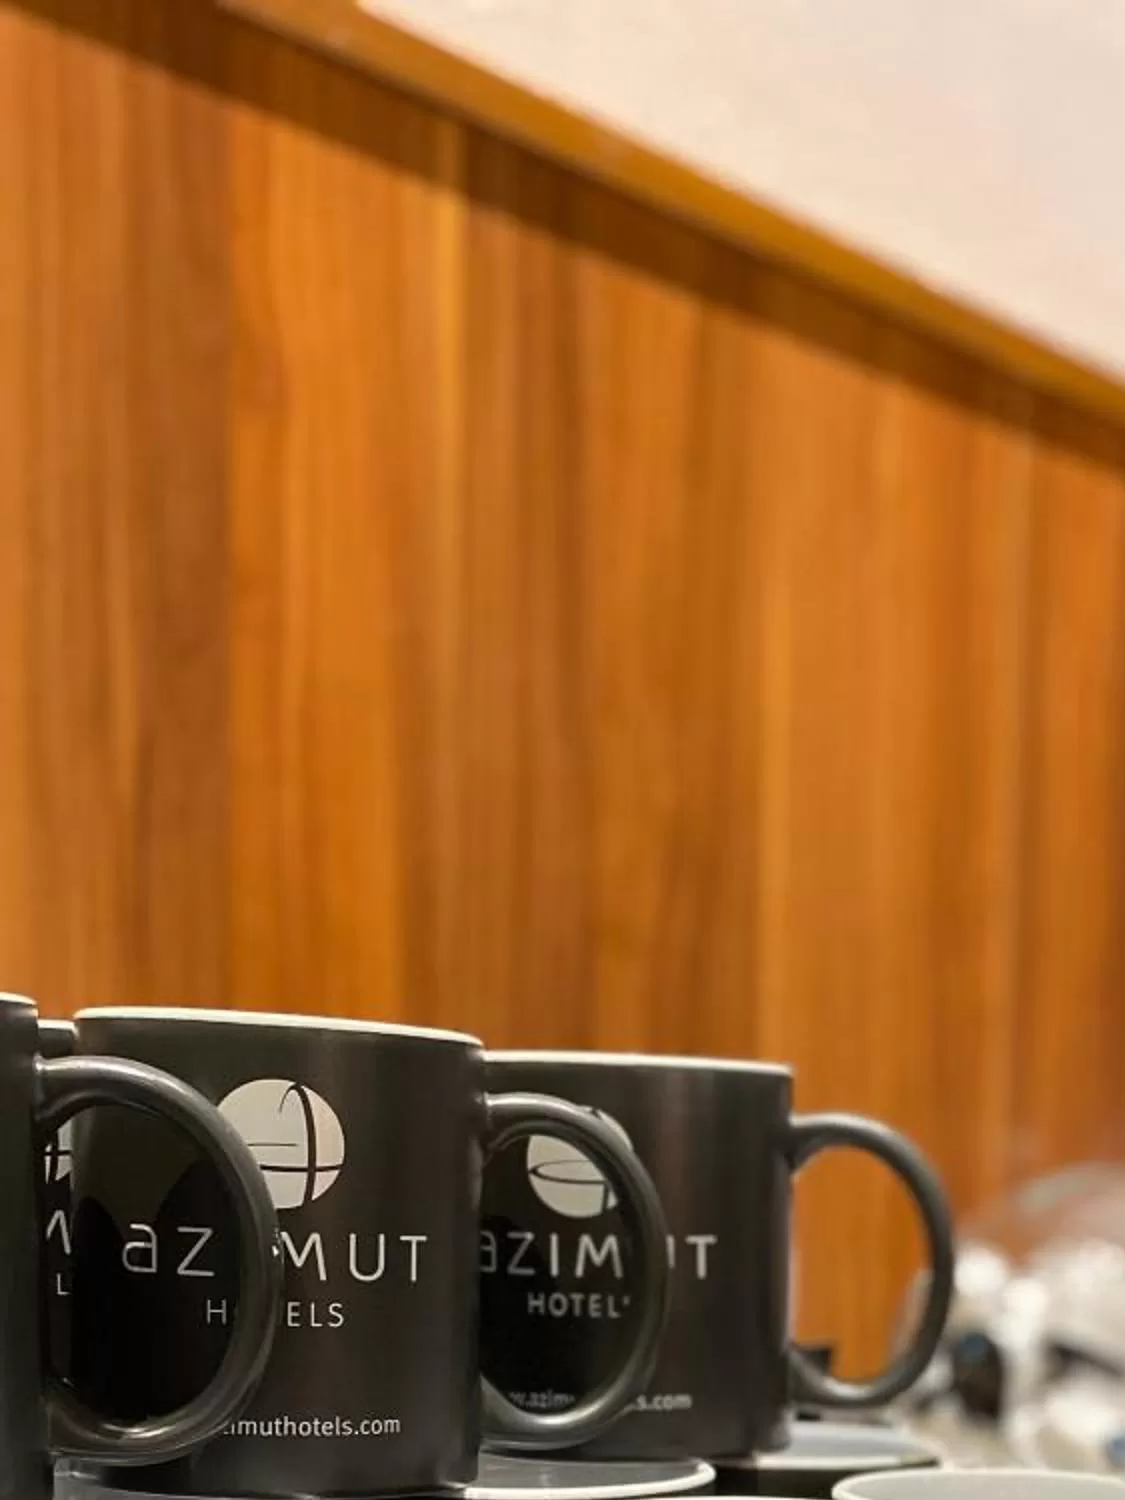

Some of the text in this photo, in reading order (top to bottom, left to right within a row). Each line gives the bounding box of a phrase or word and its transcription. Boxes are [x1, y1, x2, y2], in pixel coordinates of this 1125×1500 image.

[206, 1299, 345, 1328] HELS
[527, 1291, 631, 1318] HOTEL
[223, 1415, 401, 1436] imuthotels.com
